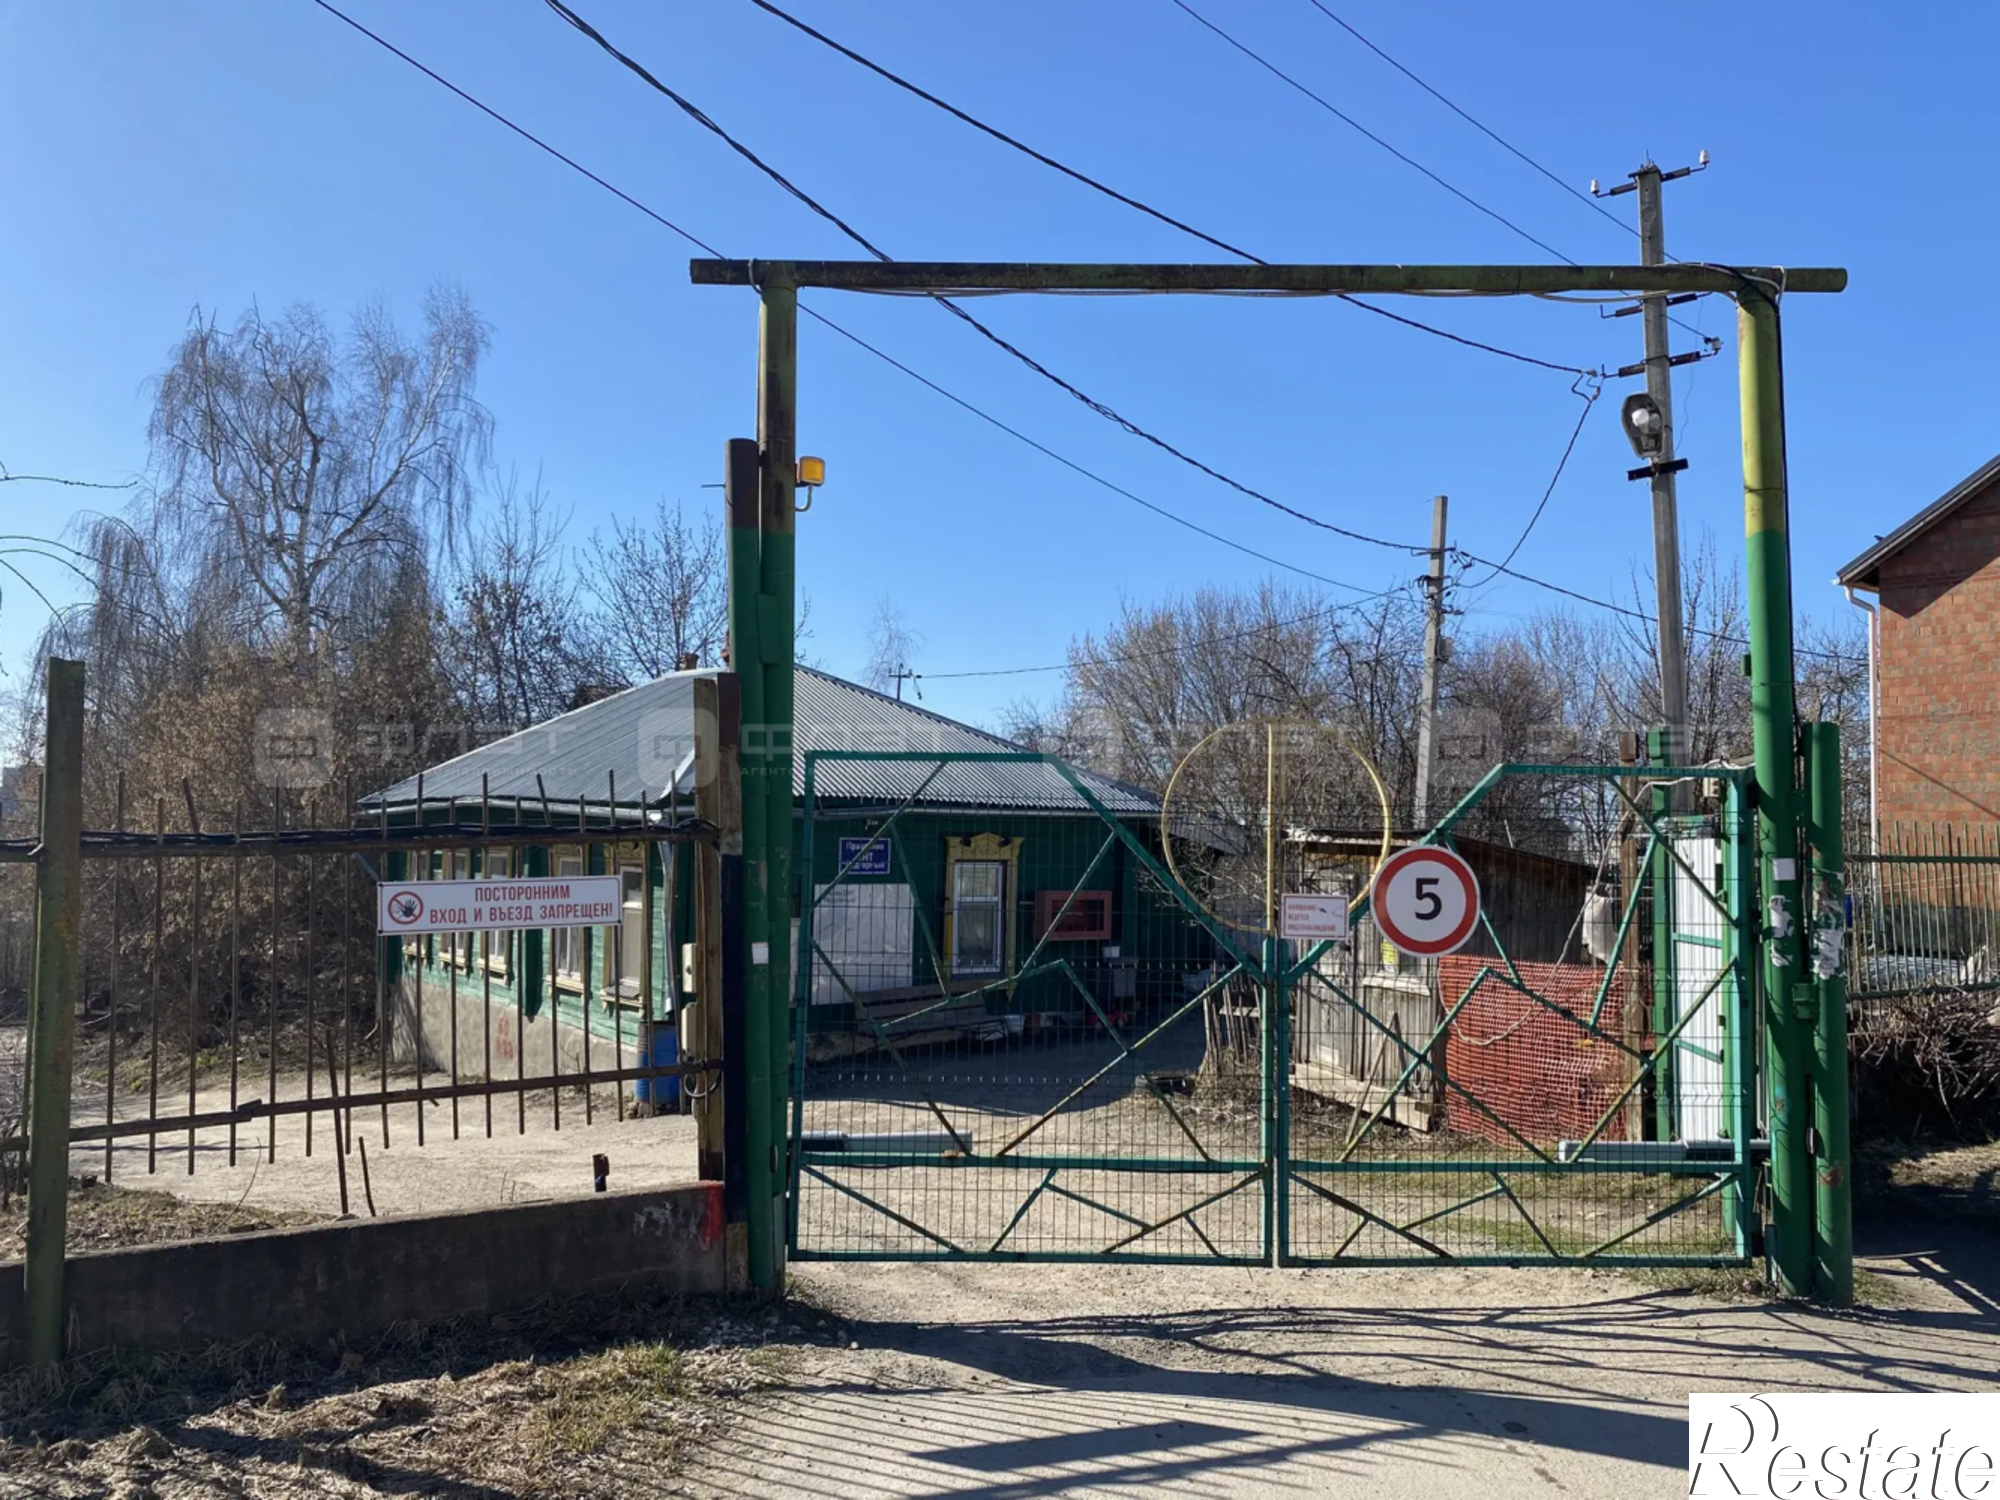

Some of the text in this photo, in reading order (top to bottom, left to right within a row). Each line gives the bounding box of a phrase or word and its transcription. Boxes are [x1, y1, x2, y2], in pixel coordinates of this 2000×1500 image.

[475, 886, 571, 902] ПОСТОРОННИМ
[1414, 878, 1443, 920] 5
[430, 902, 613, 924] ВХОД И ВЪЕЗД ЗАПРЕЩЕН!
